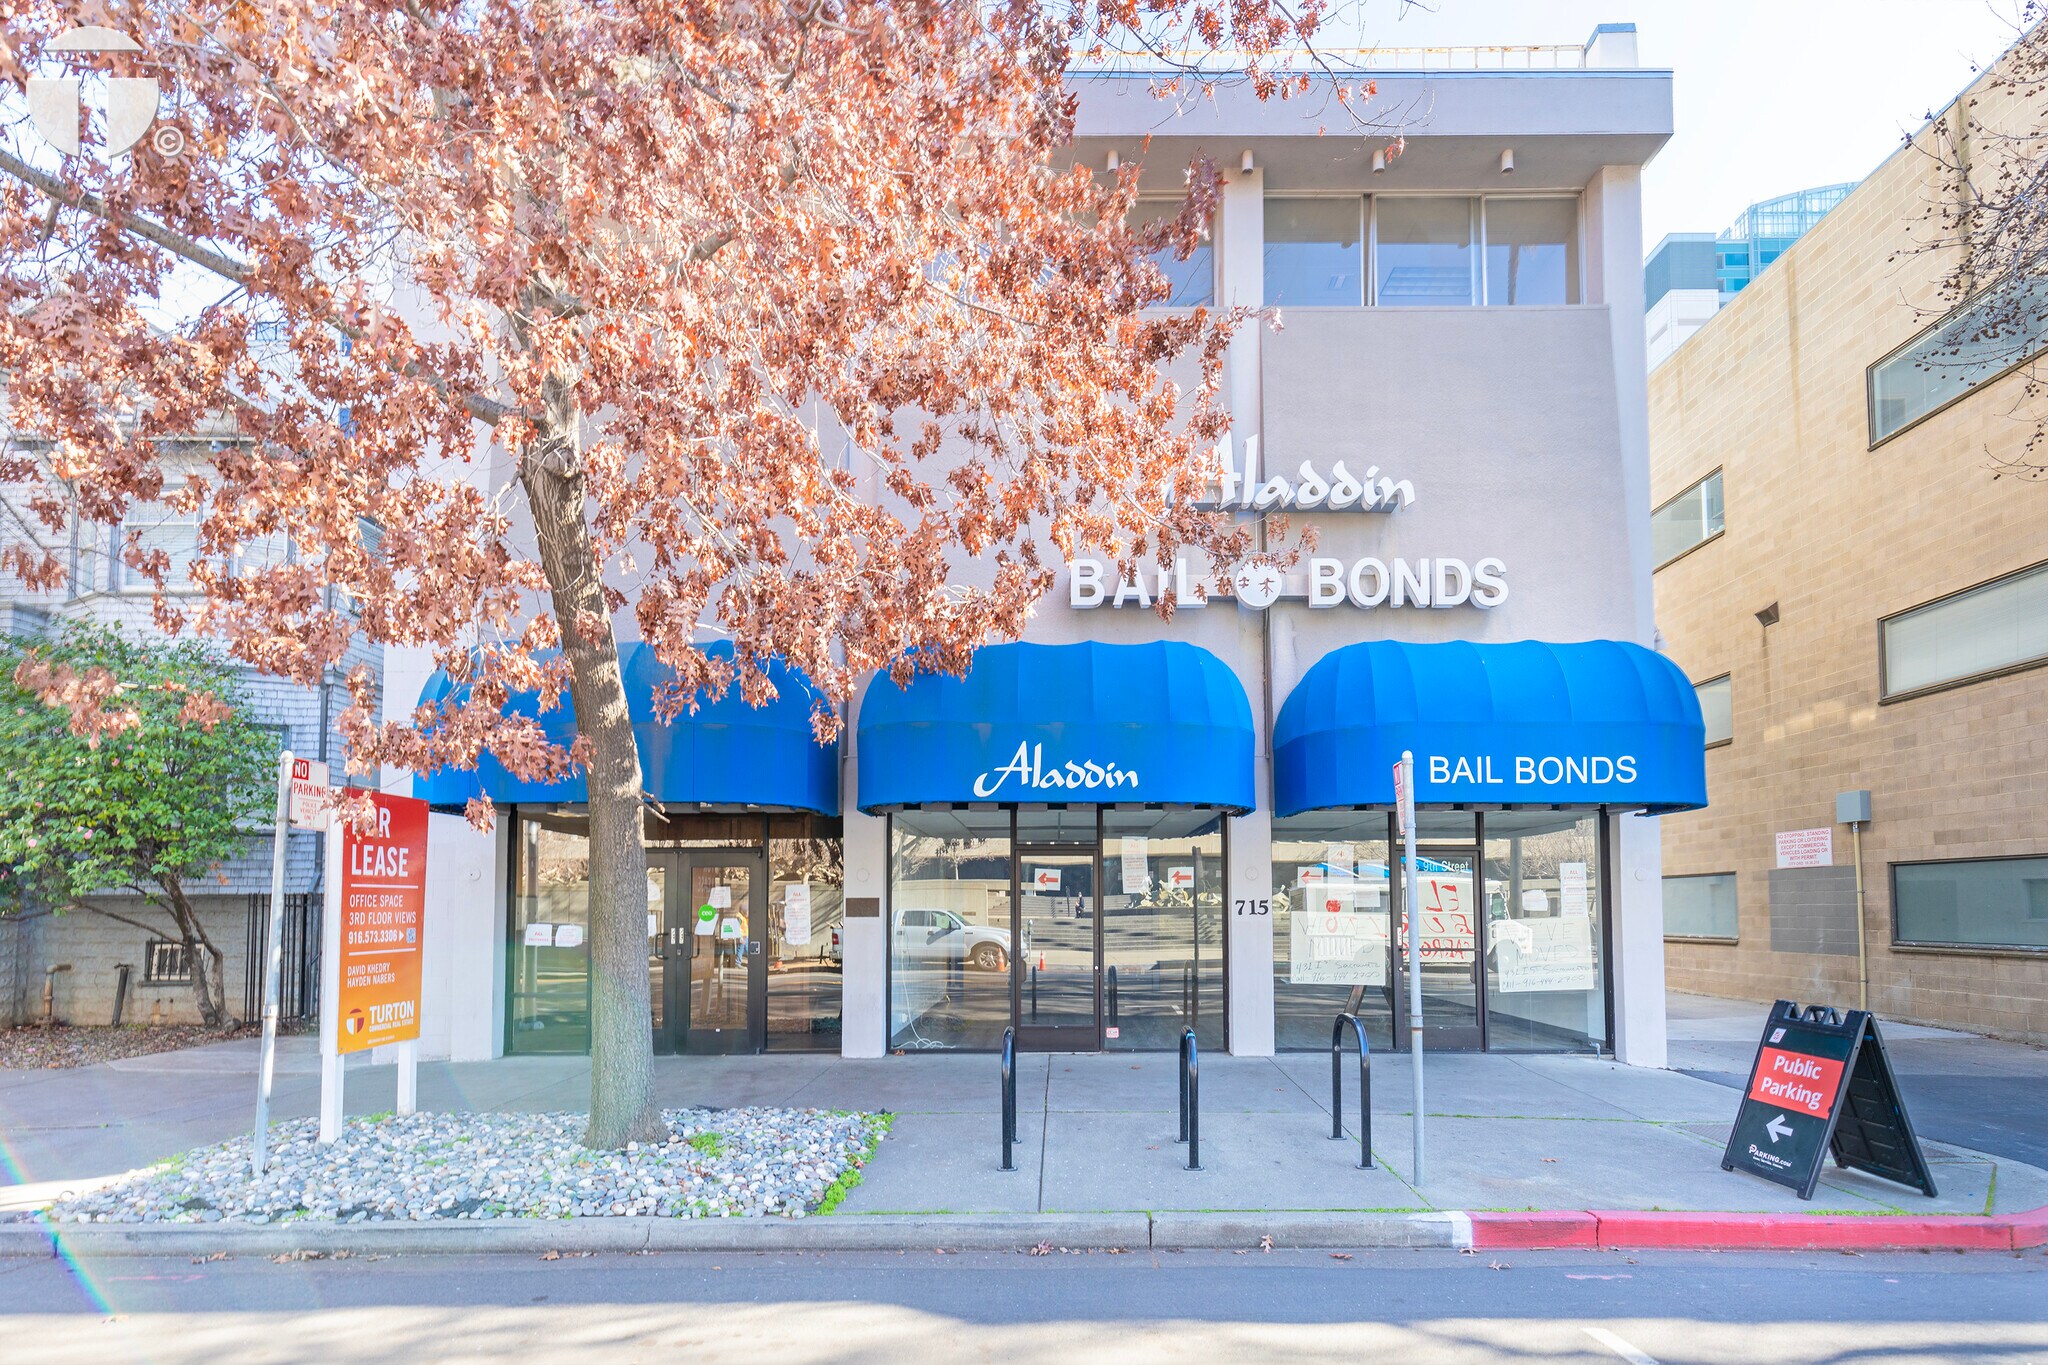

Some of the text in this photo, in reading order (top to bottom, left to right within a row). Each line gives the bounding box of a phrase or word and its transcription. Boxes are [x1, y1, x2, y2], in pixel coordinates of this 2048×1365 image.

[1070, 557, 1509, 609] BAIL BONDS
[294, 761, 308, 778] NO
[973, 740, 1139, 798] Aladdin
[1429, 755, 1638, 784] BAIL BONDS
[294, 782, 328, 798] PARKING
[351, 843, 409, 879] LEASE
[1441, 860, 1469, 872] Street
[349, 894, 404, 908] OFFICE SPACE
[1234, 899, 1270, 916] 715
[349, 911, 417, 926] 3RD FLOOR VIEWS
[348, 929, 398, 944] 916.573.3306
[347, 964, 366, 977] DAVID
[347, 972, 396, 988] HAYDEN NABERS
[369, 1000, 415, 1025] TURTON
[1773, 1055, 1823, 1080] Public
[1760, 1077, 1823, 1110] Parking
